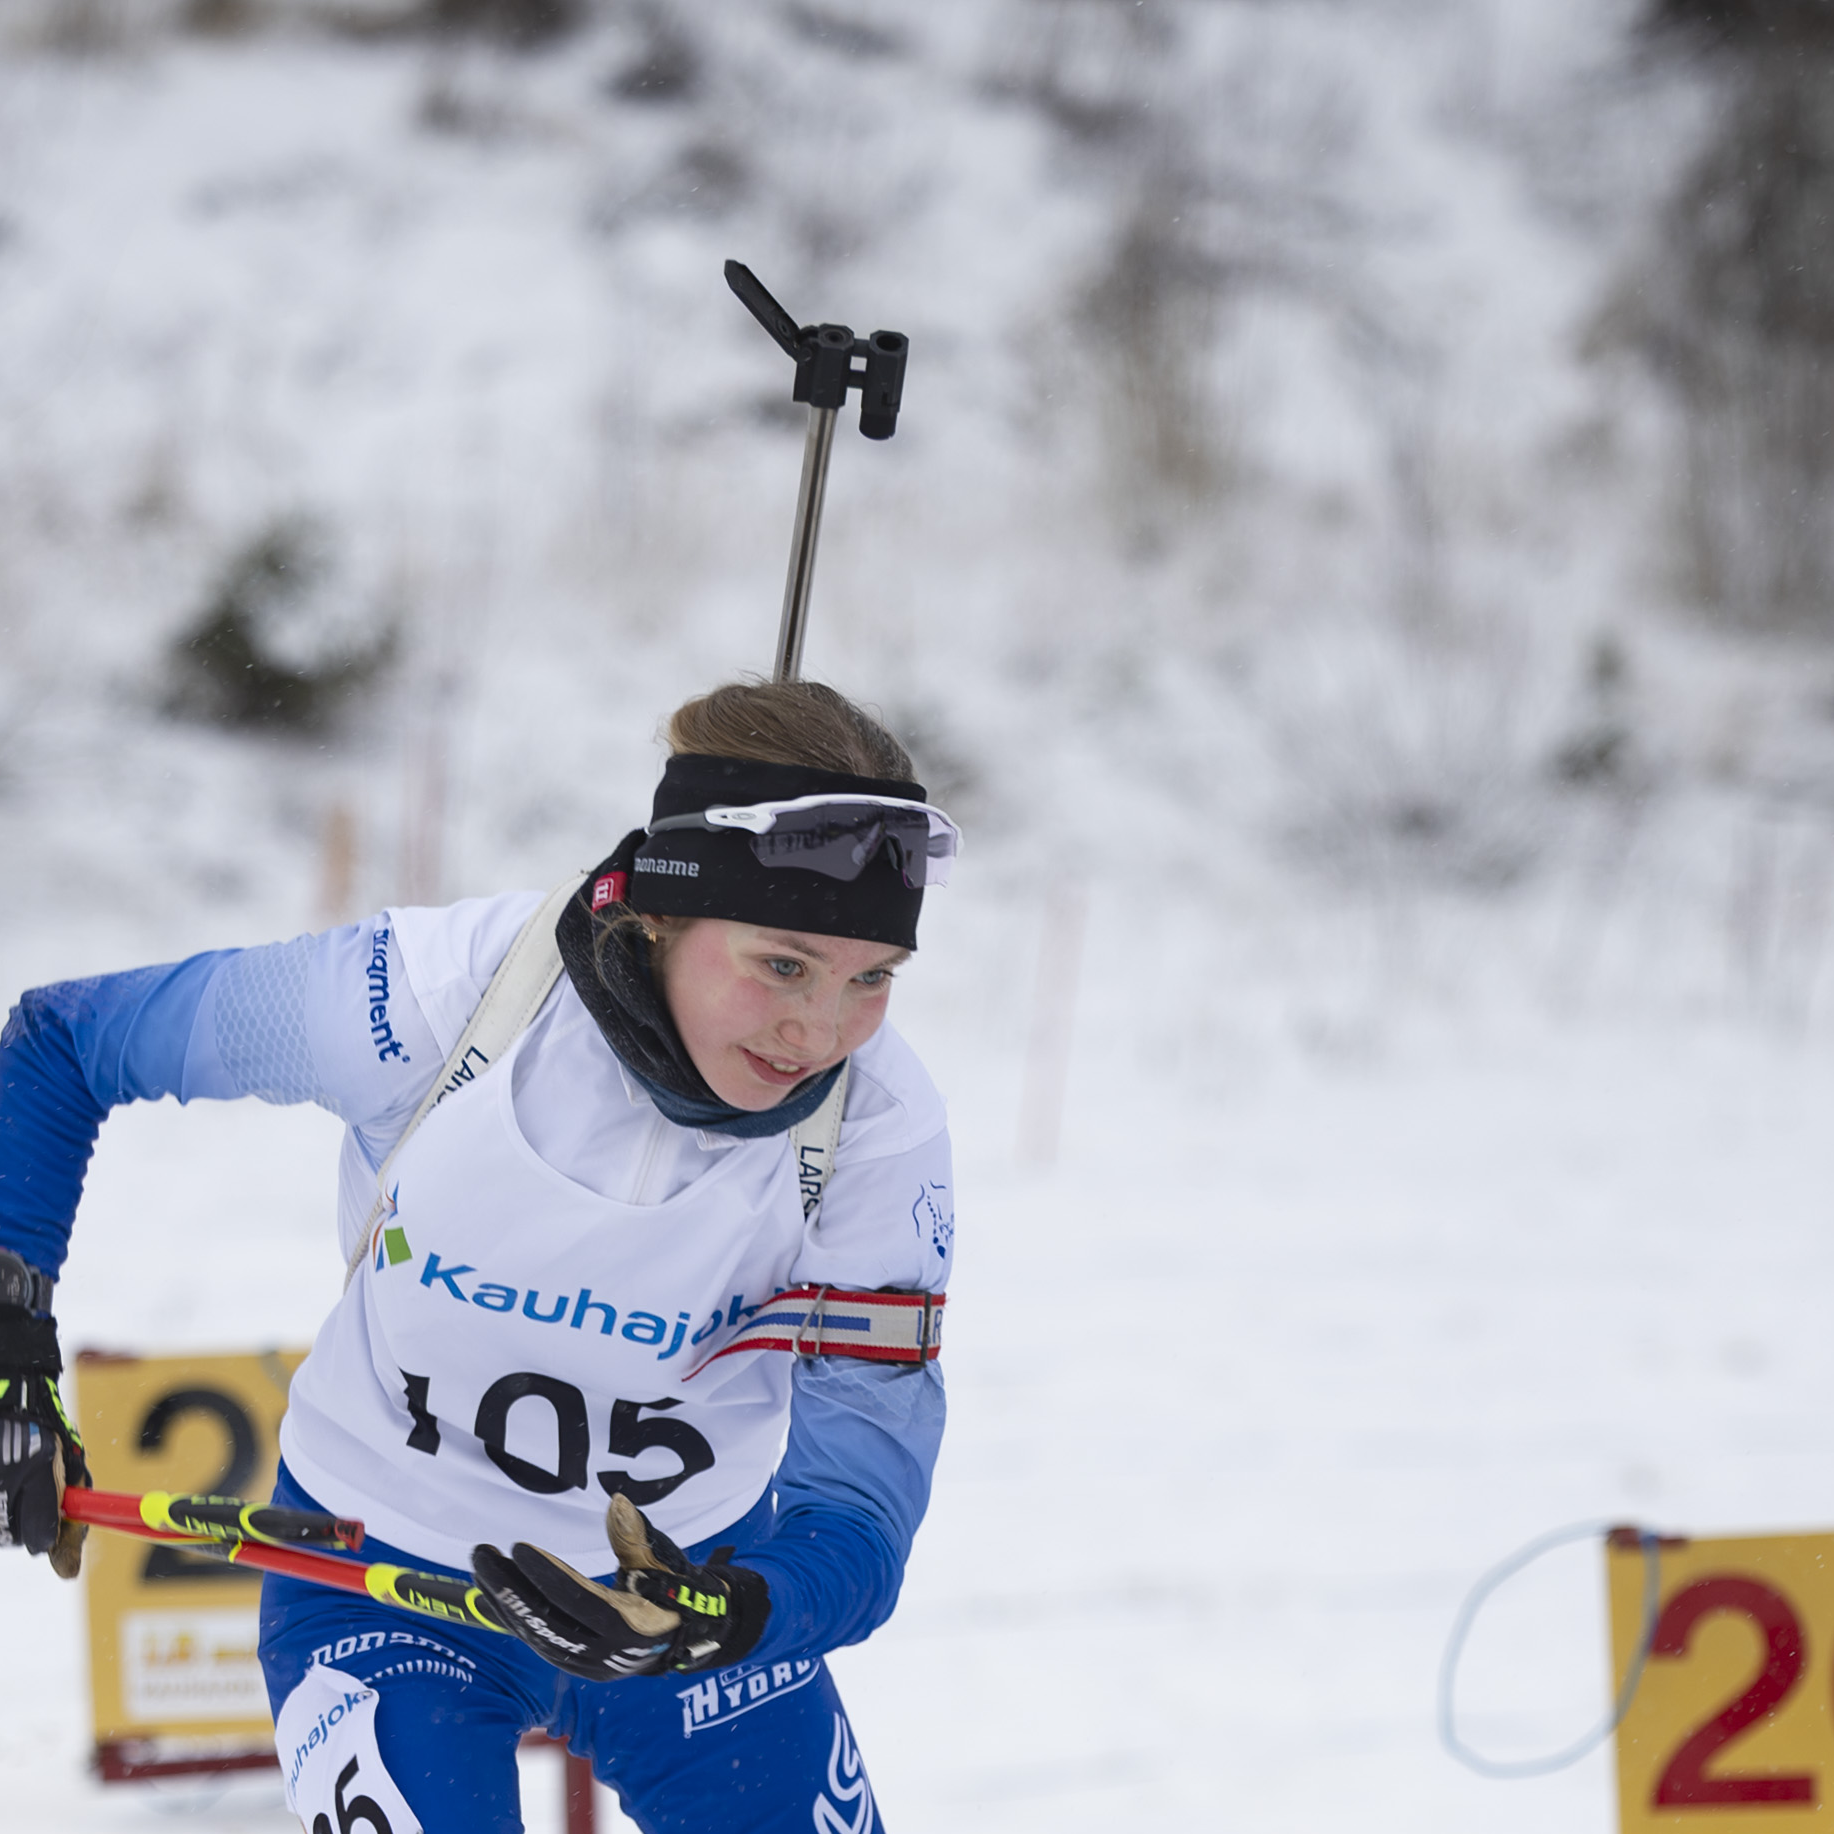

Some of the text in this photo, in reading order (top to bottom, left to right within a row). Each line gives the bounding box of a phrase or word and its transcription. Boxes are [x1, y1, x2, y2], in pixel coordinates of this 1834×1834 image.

[419, 1252, 785, 1361] Kauhajok
[135, 1384, 271, 1579] 2
[400, 1368, 716, 1506] 105
[409, 1587, 467, 1623] LEKI
[678, 1584, 737, 1617] LEKI
[288, 1691, 372, 1800] uhajok
